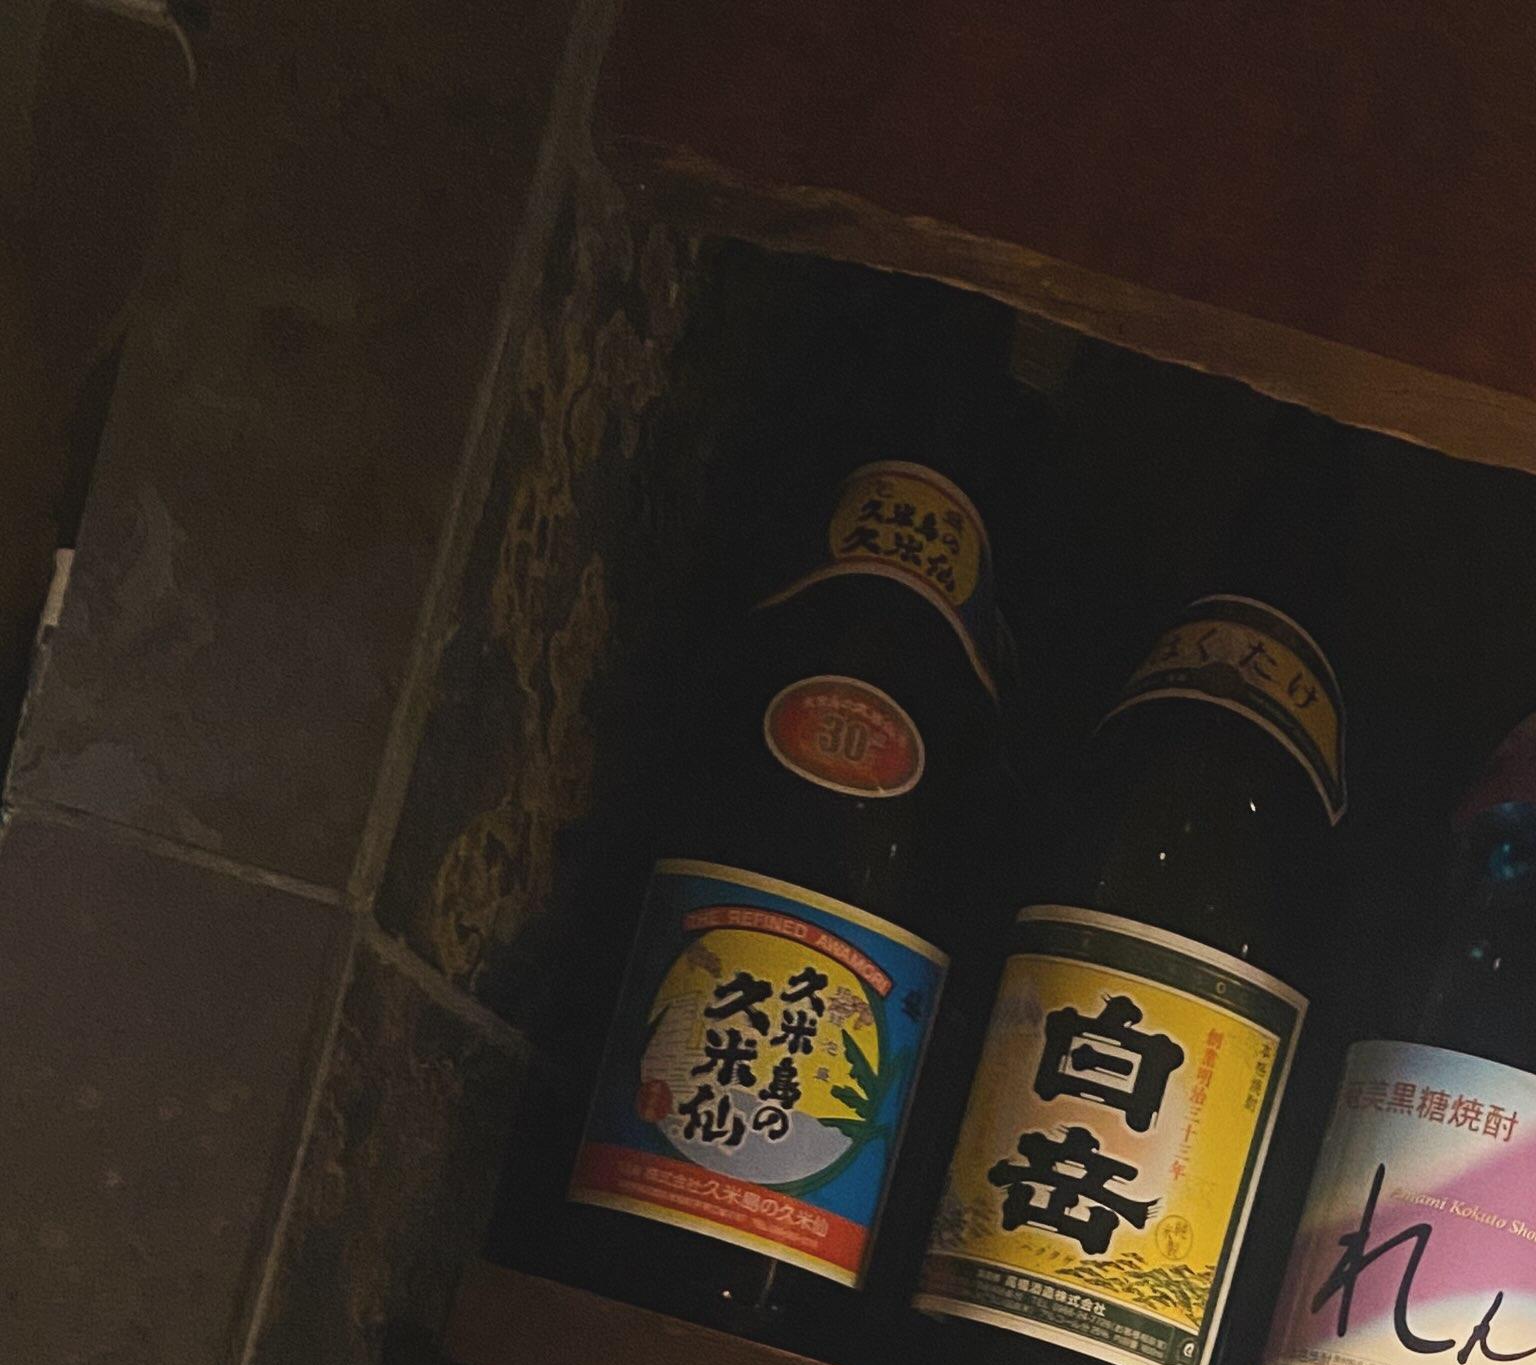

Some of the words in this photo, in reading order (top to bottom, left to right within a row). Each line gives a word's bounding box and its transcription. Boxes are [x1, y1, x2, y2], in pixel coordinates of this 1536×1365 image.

[728, 909, 807, 940] REFINED
[815, 932, 890, 993] AWAMORI
[678, 970, 773, 1147] 久米仙
[752, 965, 829, 1140] 久米島の
[987, 994, 1187, 1255] 白岳
[1449, 1201, 1508, 1230] Kokuto
